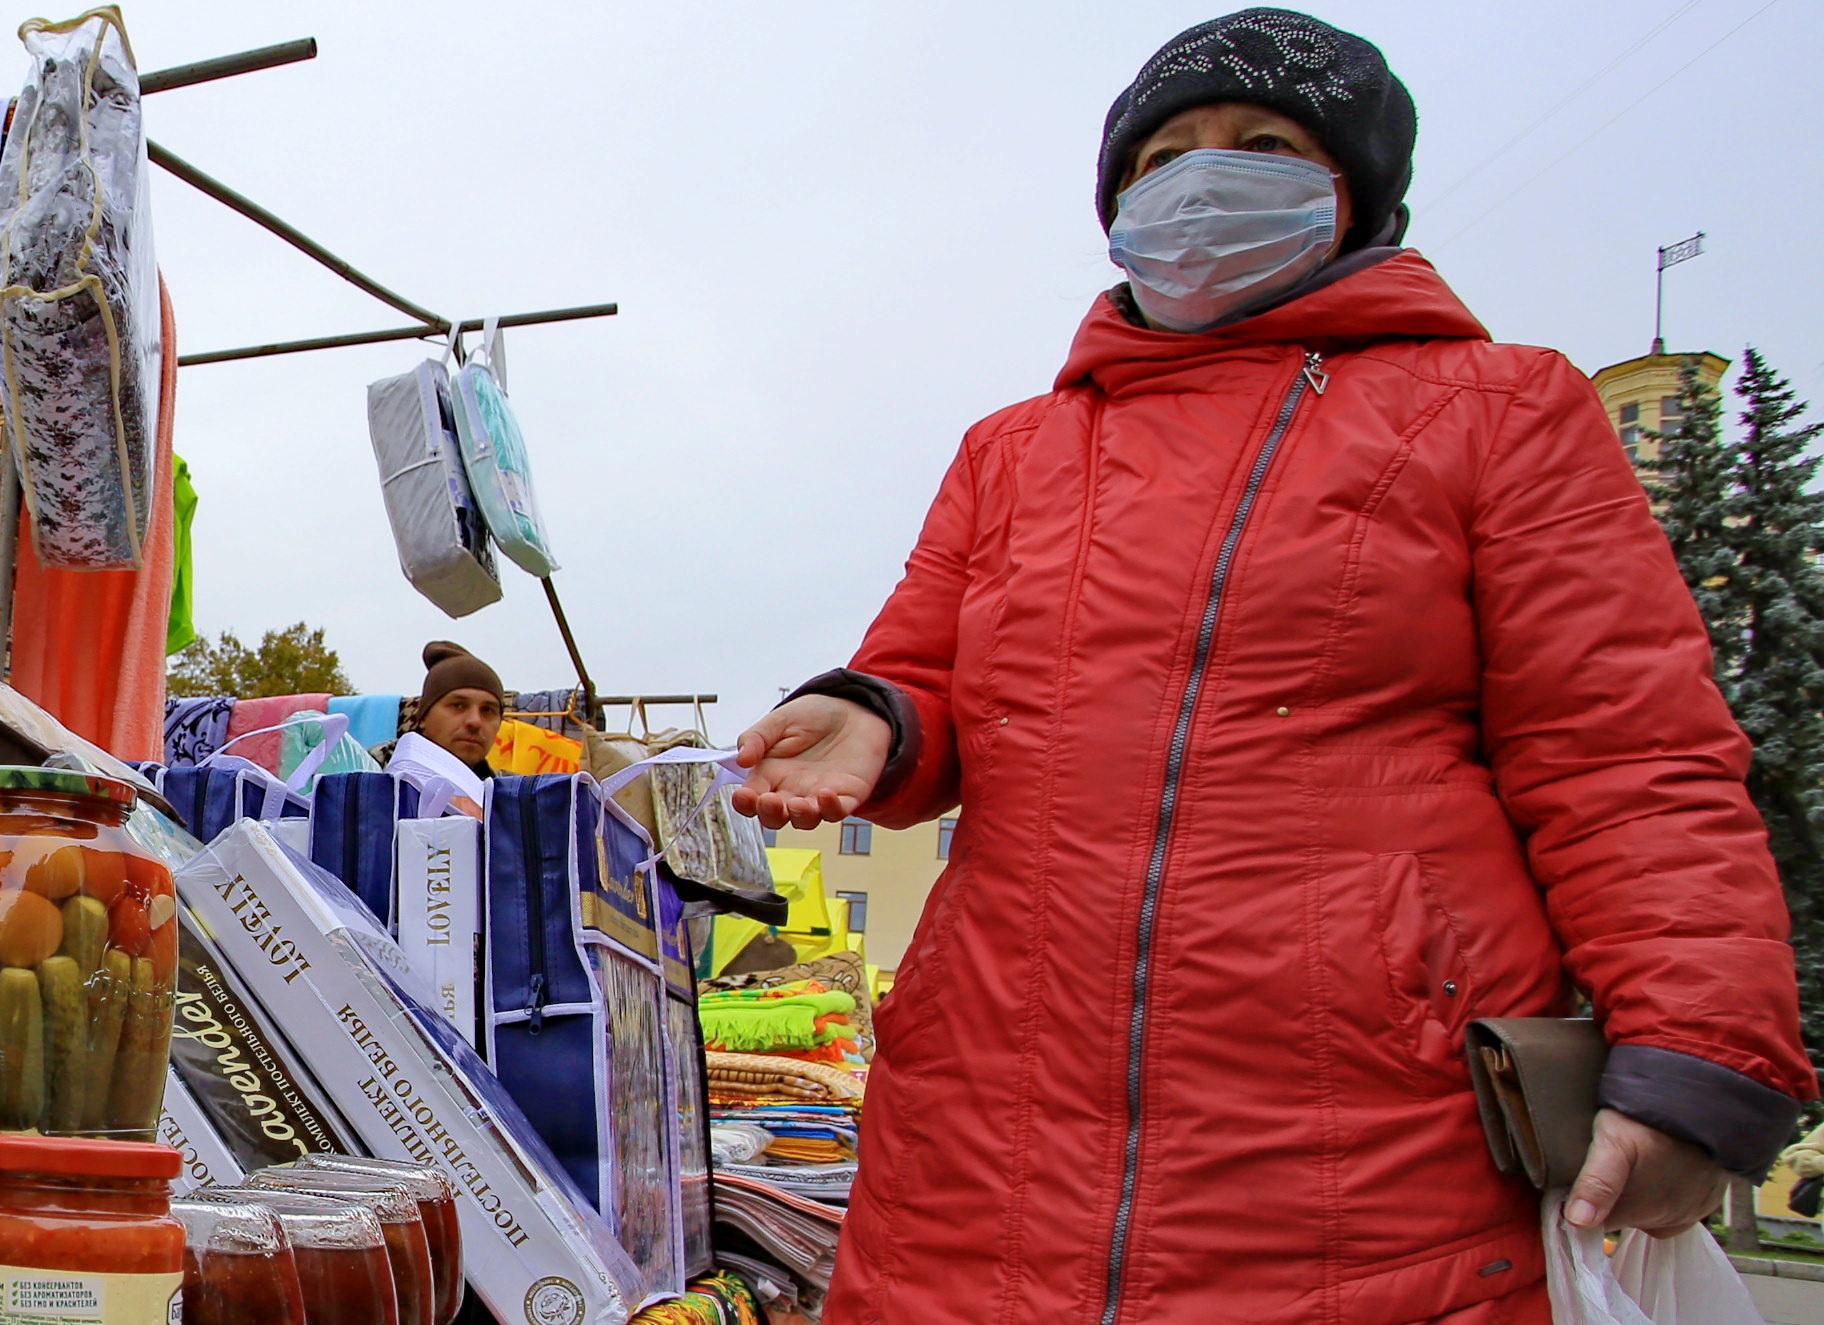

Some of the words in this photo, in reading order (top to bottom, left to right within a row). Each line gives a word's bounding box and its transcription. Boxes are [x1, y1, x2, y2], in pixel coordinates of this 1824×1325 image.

[213, 872, 313, 985] LOVELY
[426, 844, 451, 946] LOVELY
[196, 964, 229, 1004] БЕЛЬЯ
[223, 1003, 289, 1090] ПОСТЕЛЬНОГО
[336, 1003, 400, 1081] БЕЛЬЯ
[393, 1079, 531, 1250] ПОСТЕЛЬНОГО
[20, 1300, 31, 1308] БЕЗ
[34, 1300, 47, 1308] ГМО
[56, 1298, 97, 1308] КРАСИТЕЛЕЙ
[33, 1282, 83, 1290] КОНСЕРВАНТОВ
[33, 1291, 92, 1299] АРОМАТИЗАТОРОВ
